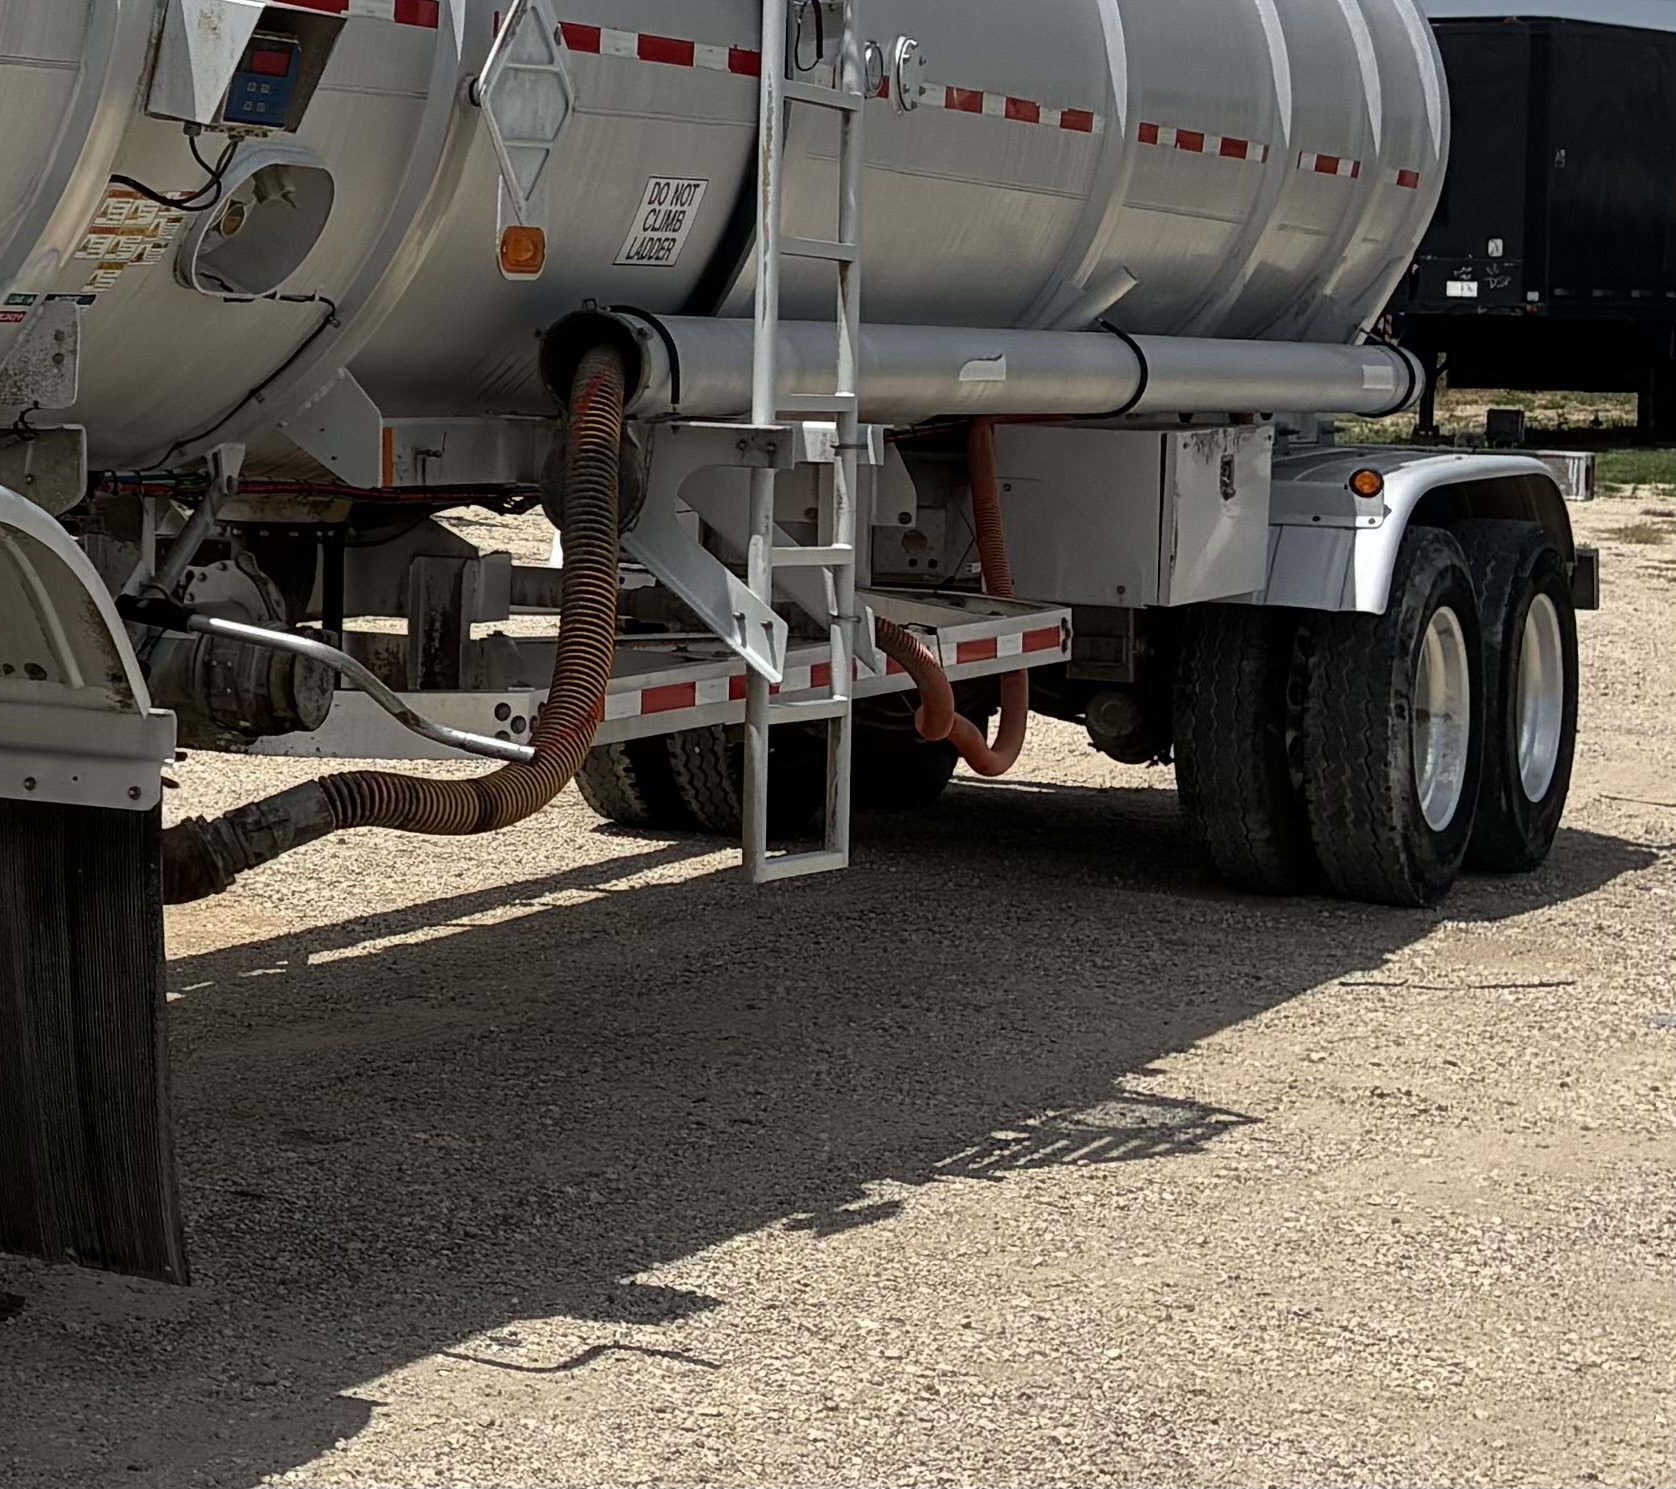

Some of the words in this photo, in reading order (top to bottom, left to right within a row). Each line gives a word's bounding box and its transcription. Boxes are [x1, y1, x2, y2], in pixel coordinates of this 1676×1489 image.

[648, 181, 670, 206] DO
[670, 183, 701, 207] NOT
[642, 208, 687, 233] CLIMB
[625, 236, 677, 261] LADDER
